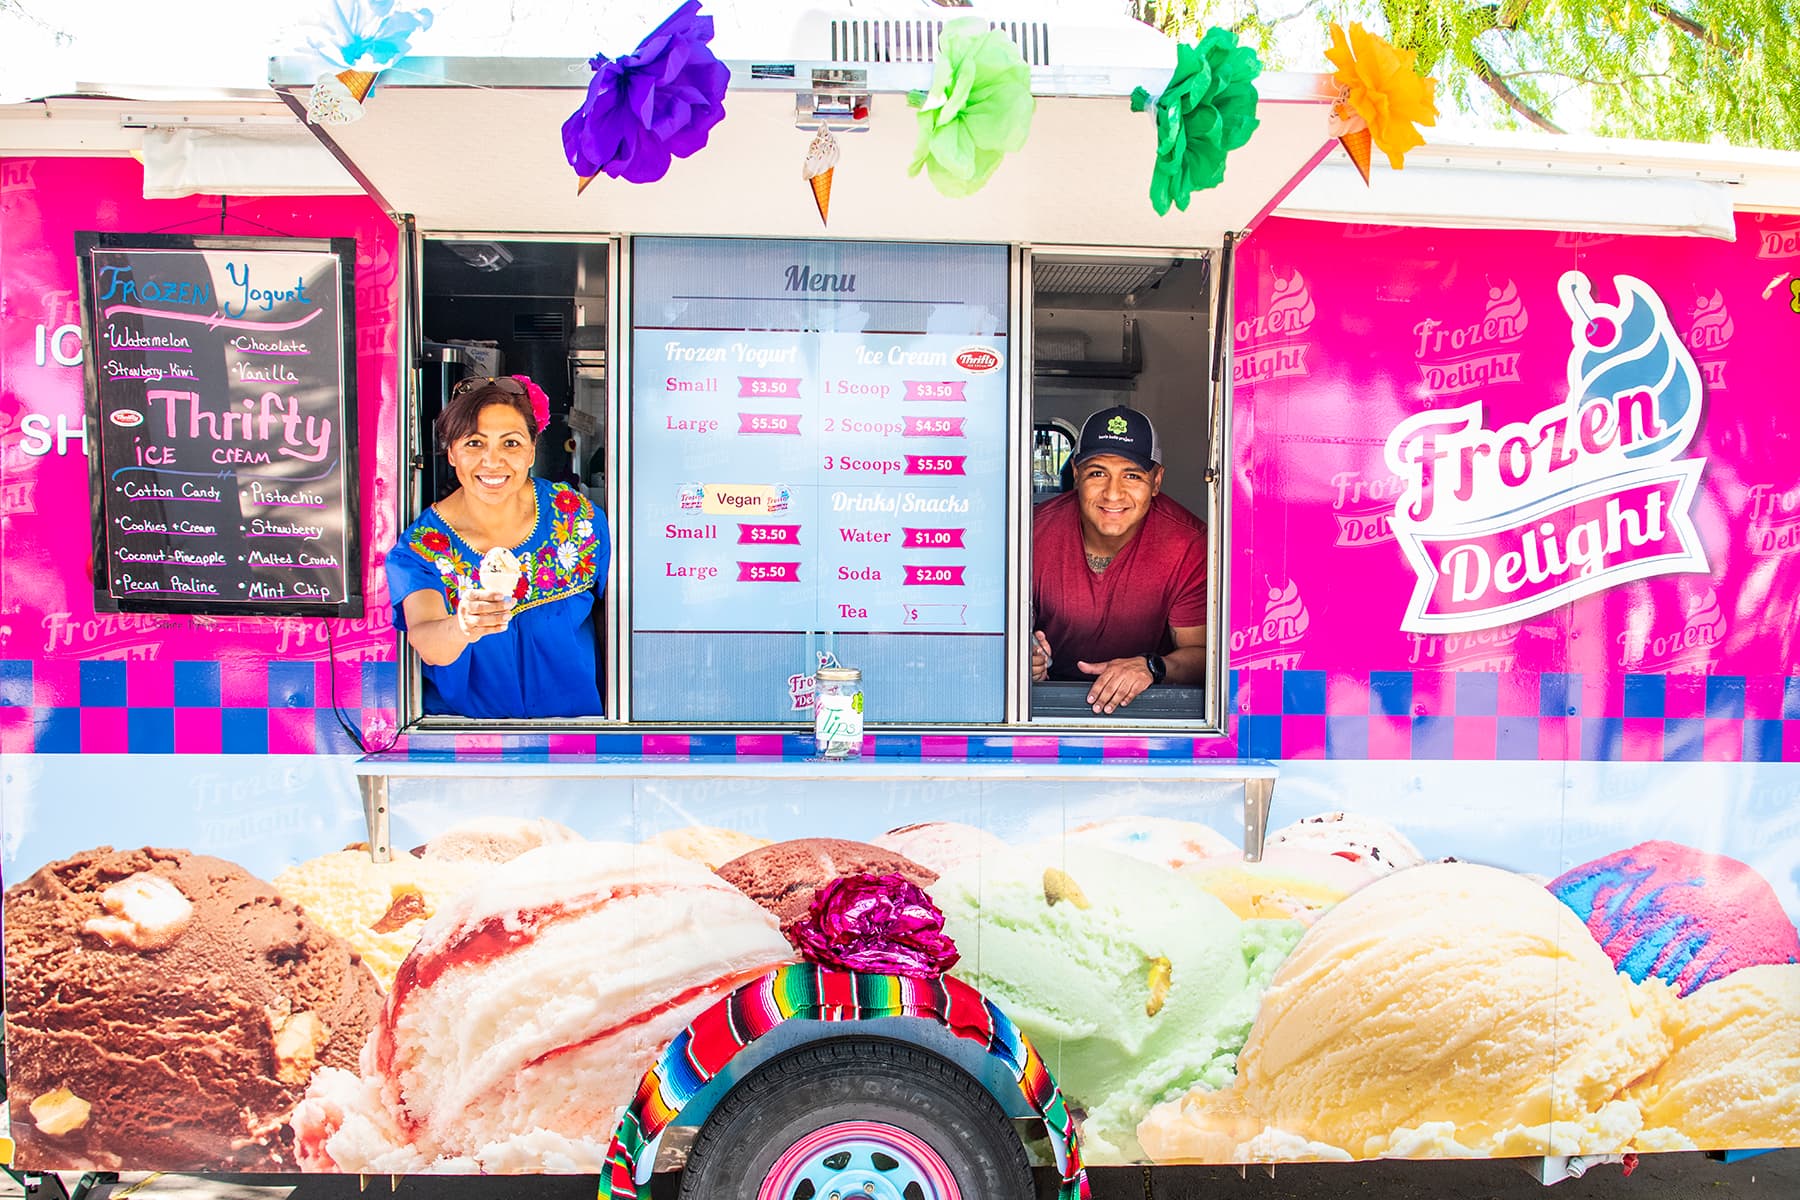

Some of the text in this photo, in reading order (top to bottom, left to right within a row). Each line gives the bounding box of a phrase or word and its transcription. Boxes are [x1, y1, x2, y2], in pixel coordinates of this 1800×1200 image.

[785, 265, 856, 292] Menu
[108, 324, 190, 349] Watermelon
[235, 335, 309, 353] Chocolate
[1413, 317, 1519, 358] Frozen
[665, 342, 798, 368] Frozen Yogurt
[855, 345, 947, 367] Ice Cream
[959, 354, 996, 367] Thrifty
[237, 361, 299, 382] Vanilla
[1426, 355, 1514, 390] Delight
[666, 377, 788, 394] Small $3.50
[825, 380, 953, 398] 1 Scoop $3.50
[146, 390, 332, 462] Thrifty
[666, 415, 788, 433] Large $5.50
[824, 418, 951, 438] 2 Scoops $4.50
[824, 455, 953, 475] 3 Scoops $5.50
[1398, 392, 1661, 523] Frozen
[124, 482, 221, 500] Cotton Candy
[250, 482, 323, 505] Pistachio
[717, 493, 761, 508] Vegan
[831, 491, 969, 517] Drinks/Snacks
[120, 516, 167, 531] Cookies
[251, 519, 323, 541] Strawberry
[665, 525, 787, 541] Small $3.50
[839, 529, 951, 544] Water $1.00
[1440, 490, 1666, 603] Delight
[249, 552, 293, 565] Malted
[665, 563, 786, 581] Large $5.50
[838, 567, 952, 582] Soda $2.00
[123, 574, 217, 593] Pecan Praline
[250, 581, 330, 602] Mint Chip
[838, 604, 868, 619] Tea
[822, 708, 858, 740] Tips
